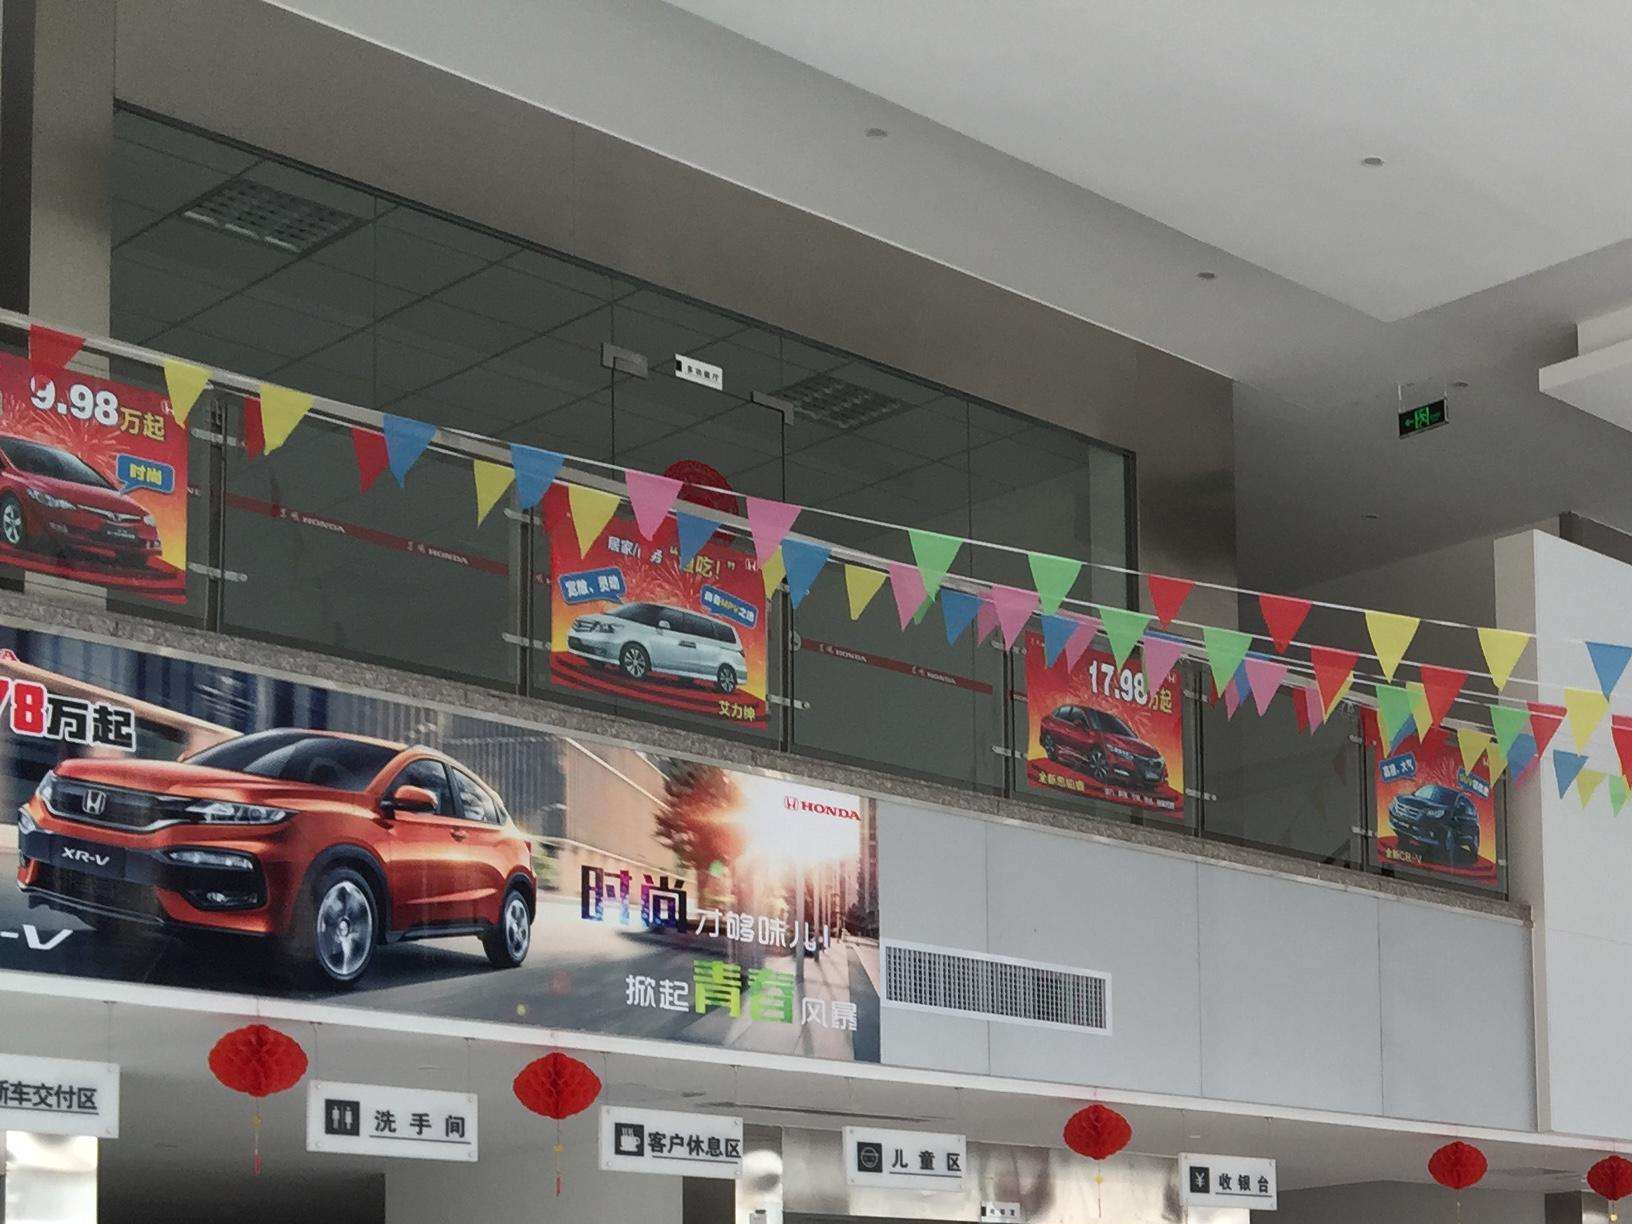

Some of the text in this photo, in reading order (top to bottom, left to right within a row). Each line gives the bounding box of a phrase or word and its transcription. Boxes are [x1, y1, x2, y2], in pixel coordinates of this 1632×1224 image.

[302, 516, 346, 534] HONDA
[800, 801, 862, 821] HONDA
[61, 846, 110, 866] XR-V
[374, 1110, 466, 1138] 洗手间
[648, 1131, 741, 1159] 客户休息区
[892, 1149, 962, 1171] 儿童区
[1219, 1173, 1269, 1193] 收银台
